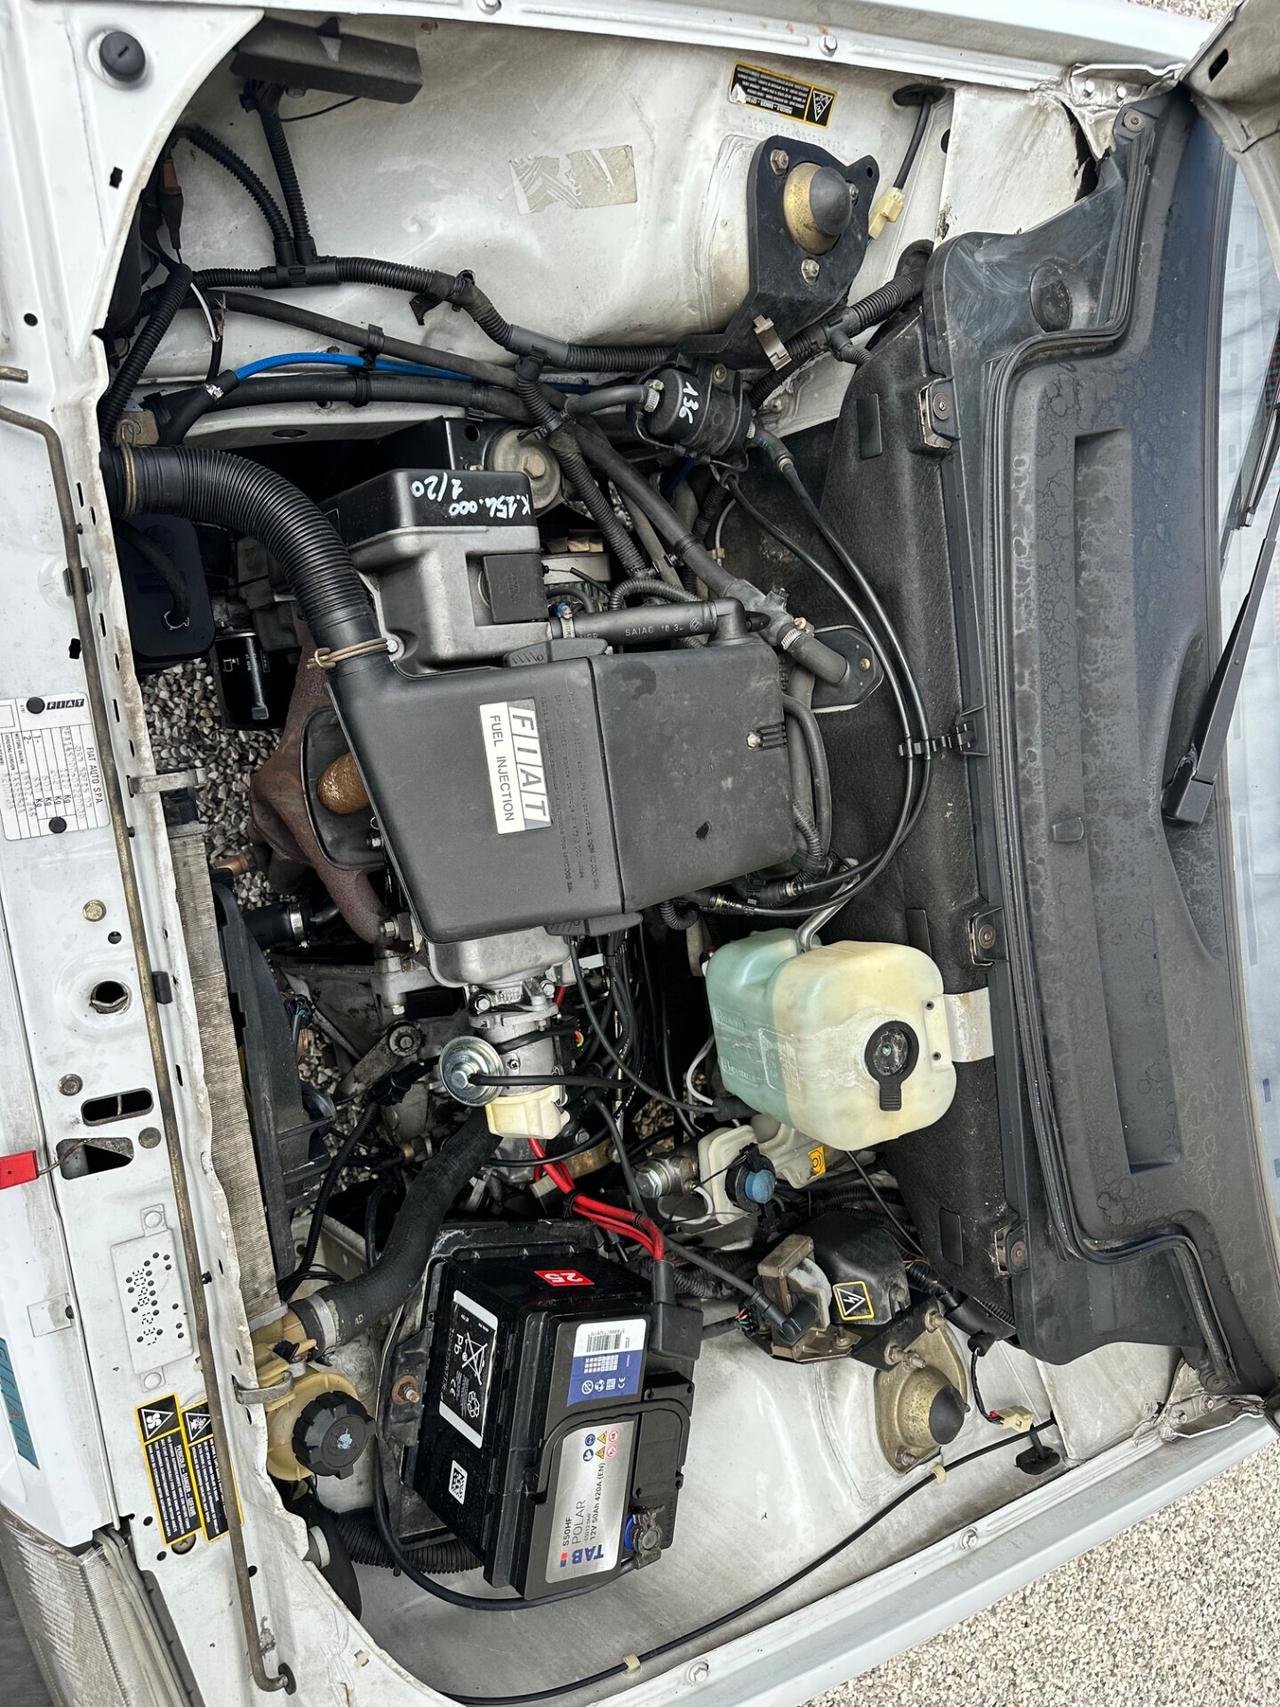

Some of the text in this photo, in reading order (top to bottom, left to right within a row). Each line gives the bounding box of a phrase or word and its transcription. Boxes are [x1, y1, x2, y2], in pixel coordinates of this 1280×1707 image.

[679, 381, 699, 424] 136
[411, 472, 463, 502] 1/20
[46, 698, 85, 711] FIAT
[86, 747, 103, 804] FIAT AUTO SPA
[490, 714, 515, 822] FUEL INJECTION
[511, 713, 547, 817] FIAT
[35, 797, 43, 808] Kg
[44, 796, 52, 807] Kg
[54, 795, 62, 806] Kg
[64, 794, 72, 804] Kg
[544, 1272, 583, 1283] 25
[453, 1333, 464, 1355] Pb
[589, 1462, 606, 1541] 12V 50Ah 420A (EN)
[562, 1516, 572, 1547] S50HF
[572, 1499, 587, 1545] POLAR
[572, 1543, 604, 1565] TAB
